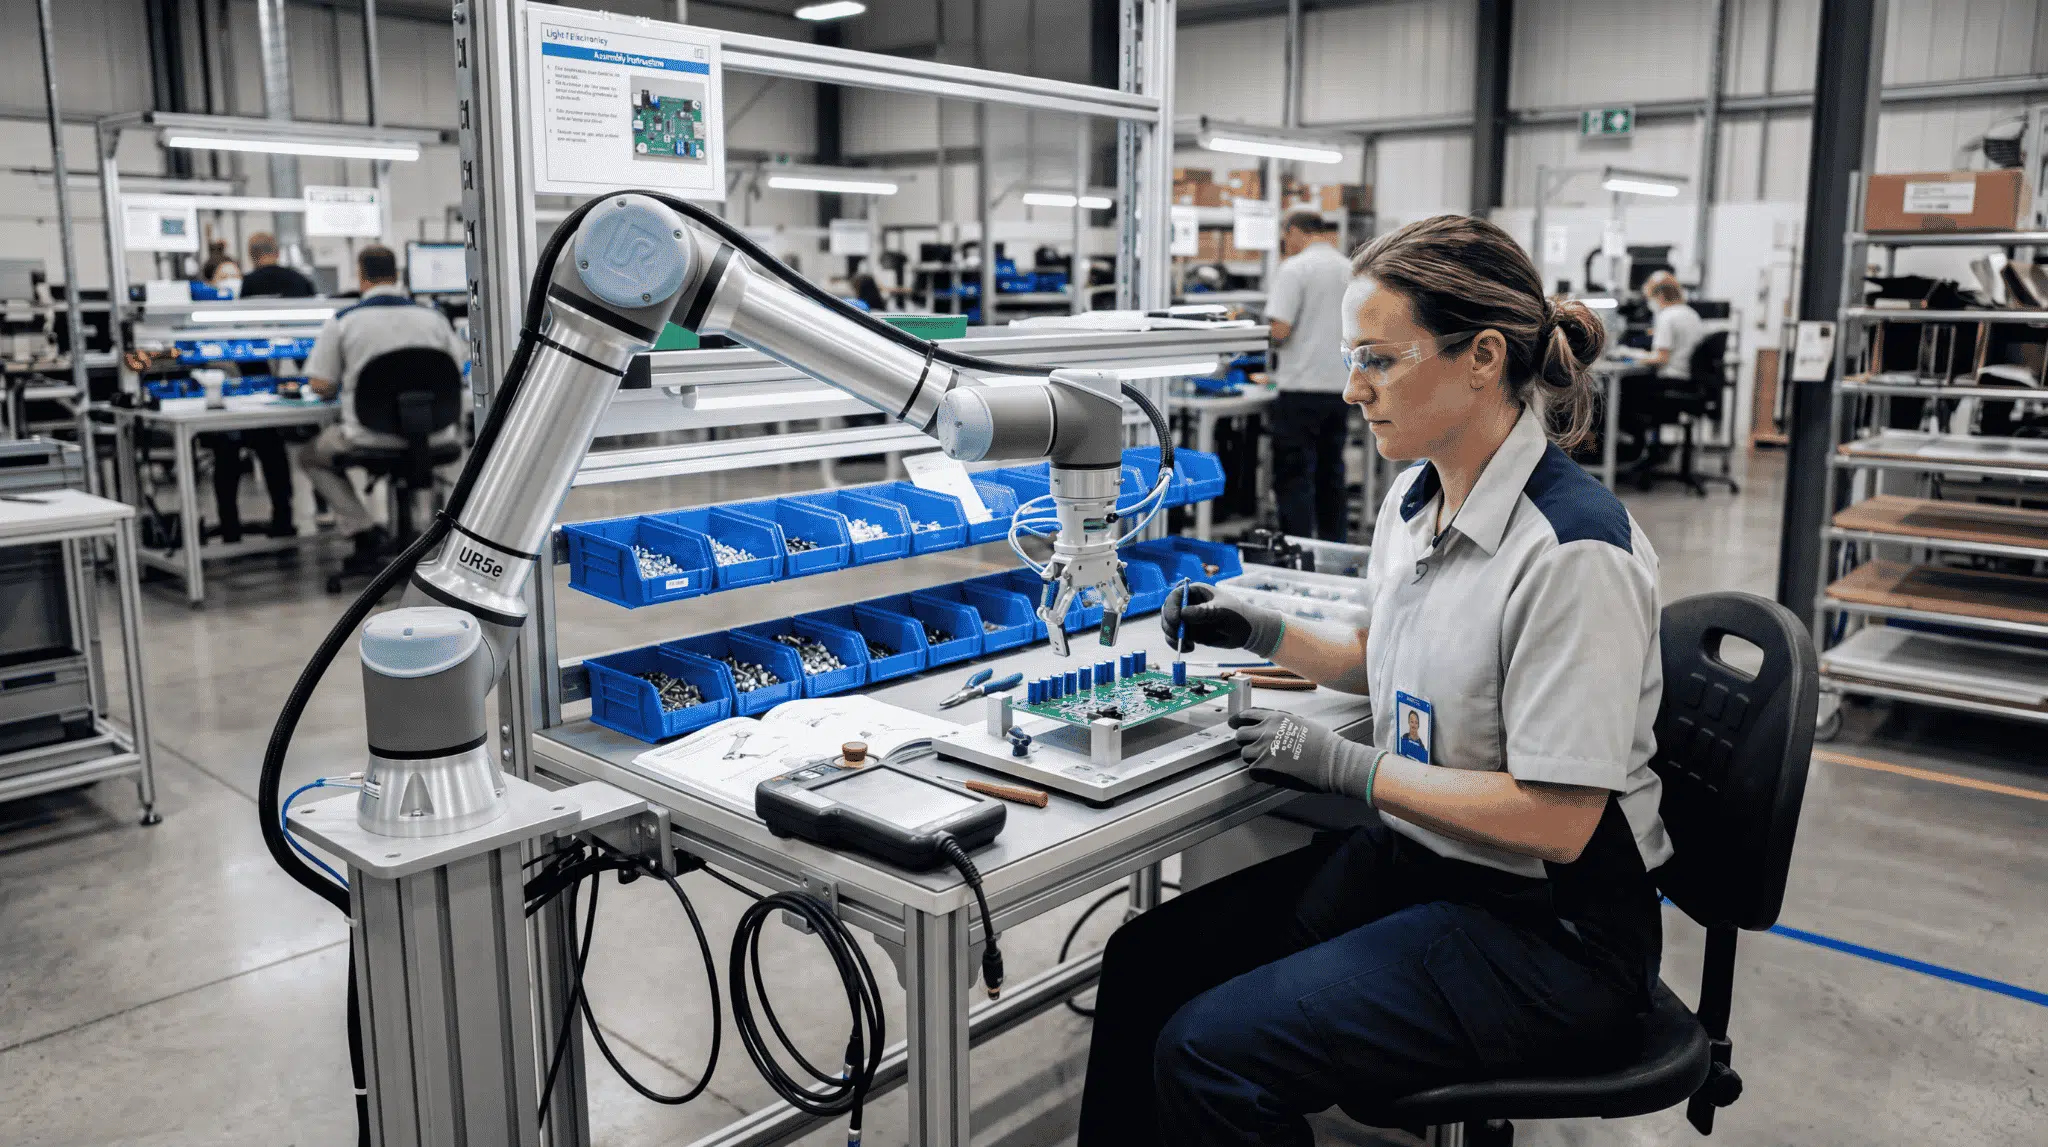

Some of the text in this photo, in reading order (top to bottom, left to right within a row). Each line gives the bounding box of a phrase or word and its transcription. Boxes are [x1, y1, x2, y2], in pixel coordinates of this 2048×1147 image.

[546, 28, 565, 40] Light
[603, 217, 663, 284] UR
[459, 546, 503, 577] UR5e
